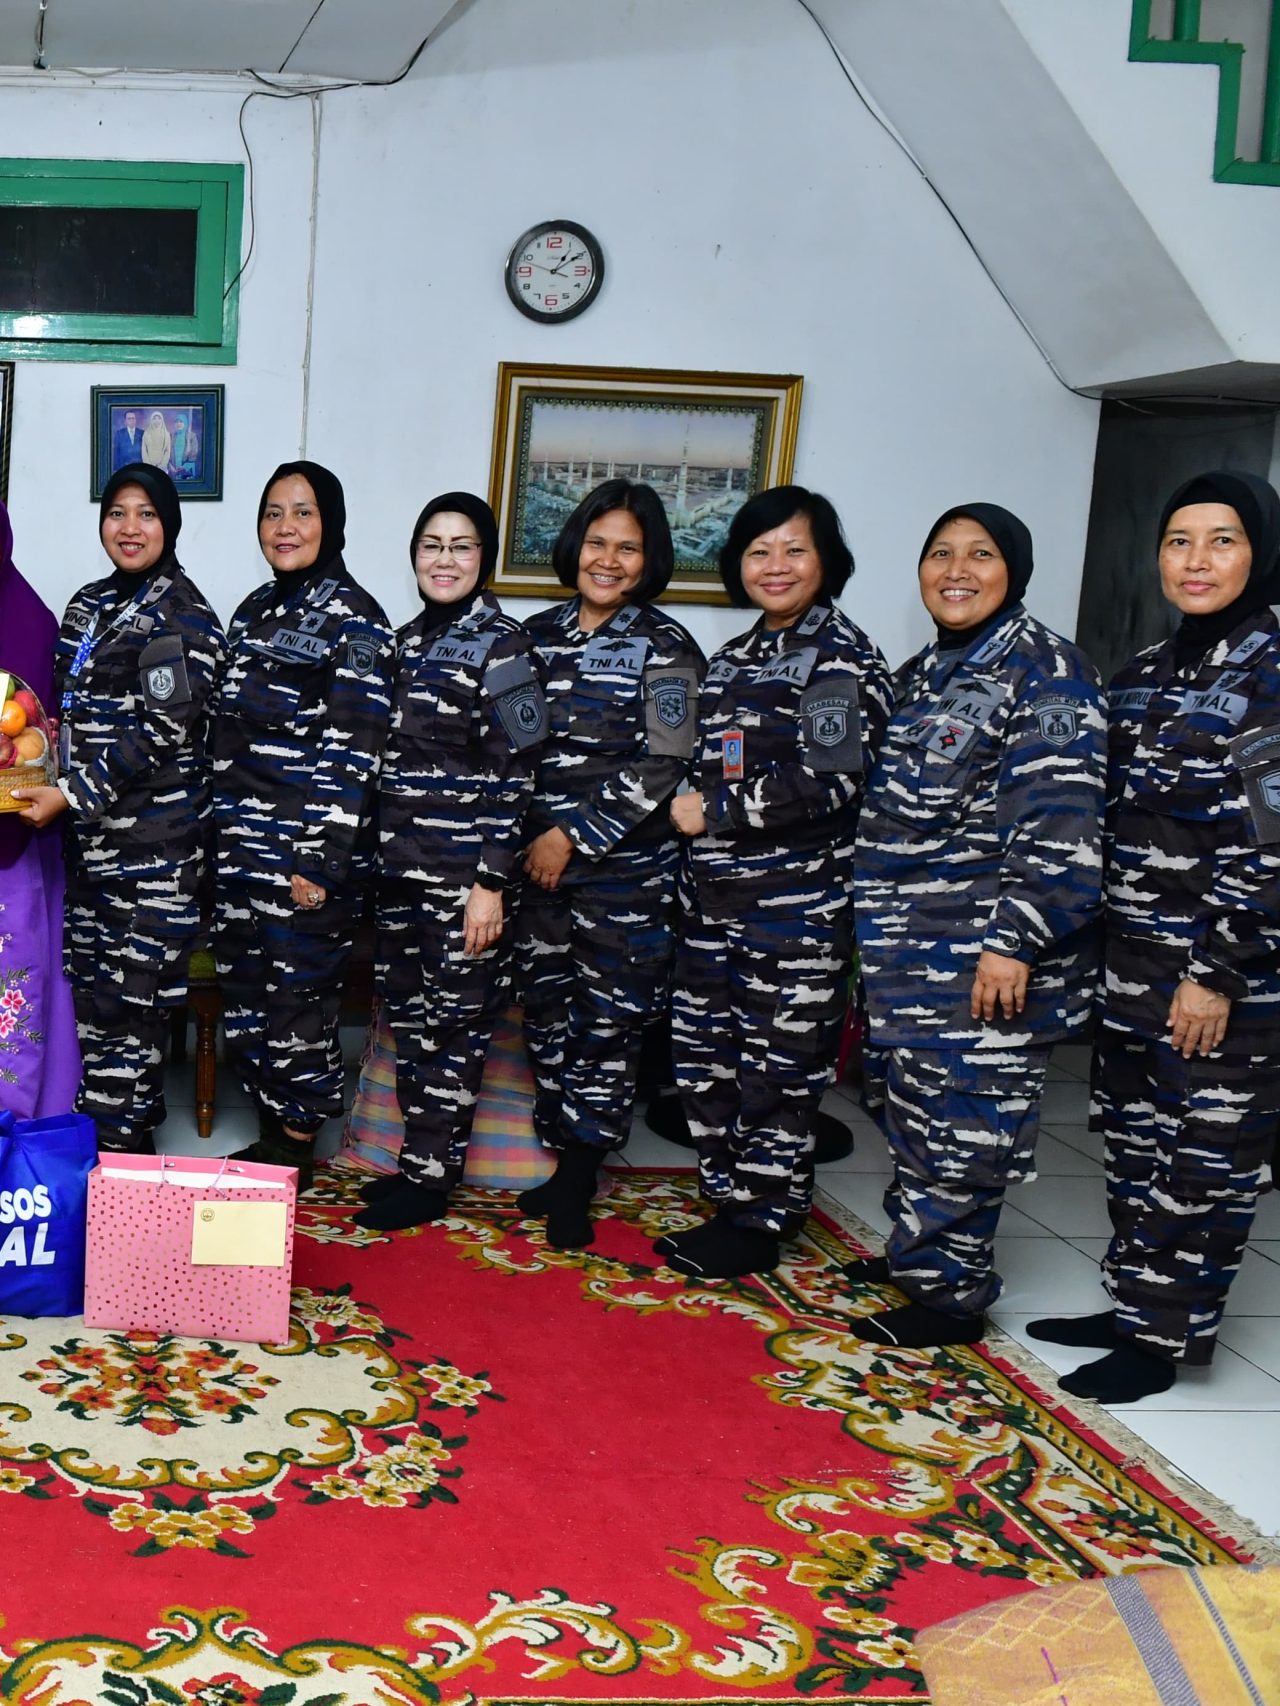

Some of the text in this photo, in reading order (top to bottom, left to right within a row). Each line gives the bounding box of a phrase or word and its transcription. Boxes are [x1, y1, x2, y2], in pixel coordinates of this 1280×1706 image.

[547, 237, 562, 248] 12
[519, 267, 531, 277] 9
[574, 266, 587, 276] 3
[545, 295, 557, 305] 6
[279, 632, 318, 654] TNI AL
[435, 646, 476, 662] TNI AL
[588, 657, 638, 671] TNI AL
[759, 665, 802, 681] TNI AL
[957, 702, 982, 720] AL
[1207, 694, 1233, 714] AL
